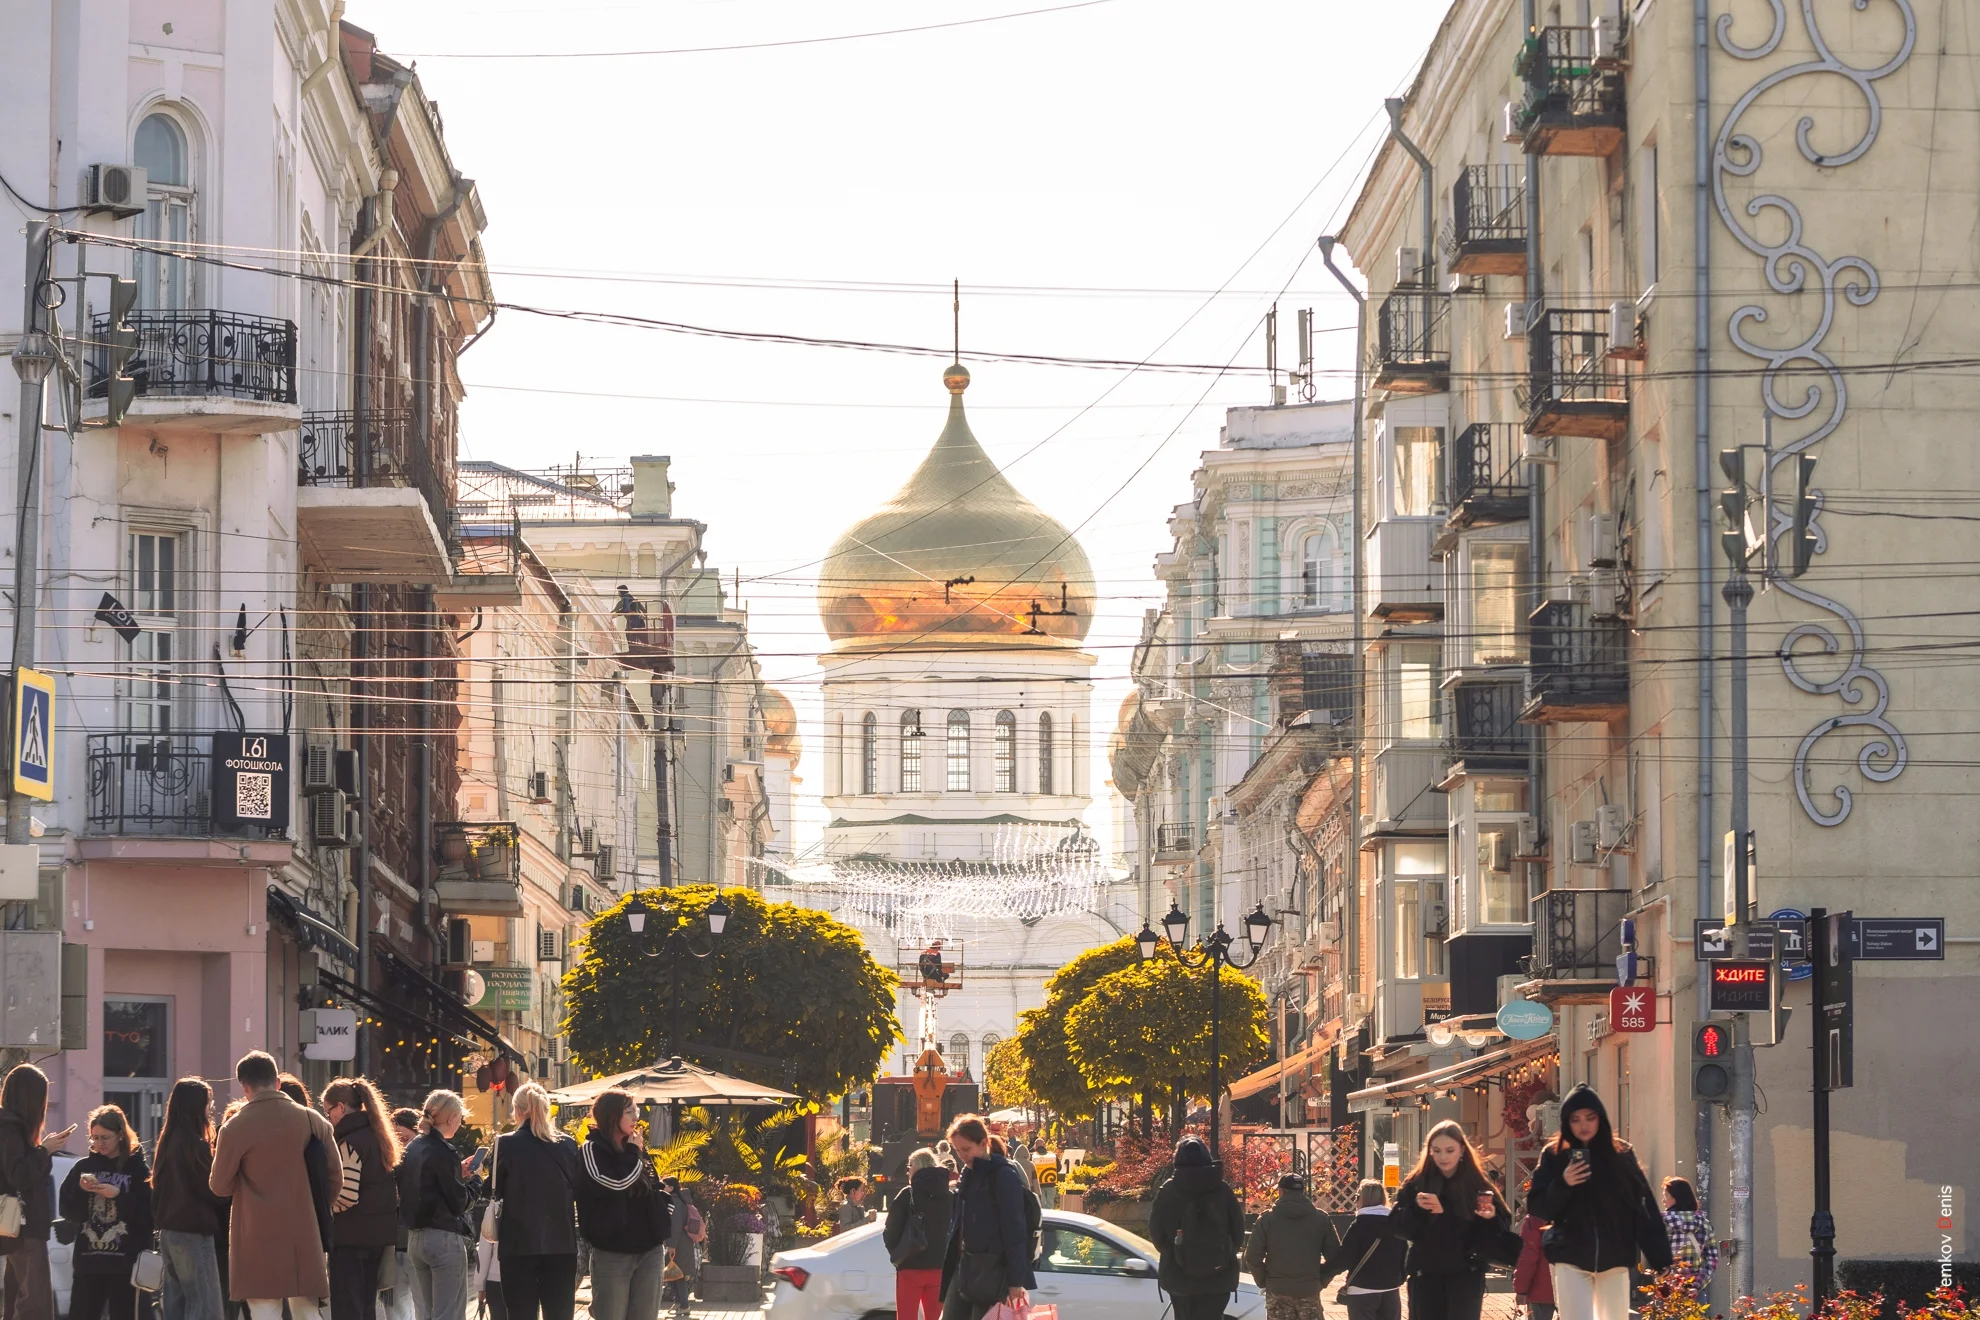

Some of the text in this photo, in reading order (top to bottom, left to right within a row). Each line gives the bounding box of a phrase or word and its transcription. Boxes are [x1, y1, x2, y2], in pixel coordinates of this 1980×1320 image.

[225, 758, 283, 772] ФОТОШКОЛА
[1716, 969, 1765, 981] ЖДИТЕ
[1717, 991, 1764, 1001] ИДИТЕ
[1430, 1012, 1446, 1021] Мир
[1621, 1017, 1646, 1028] 585
